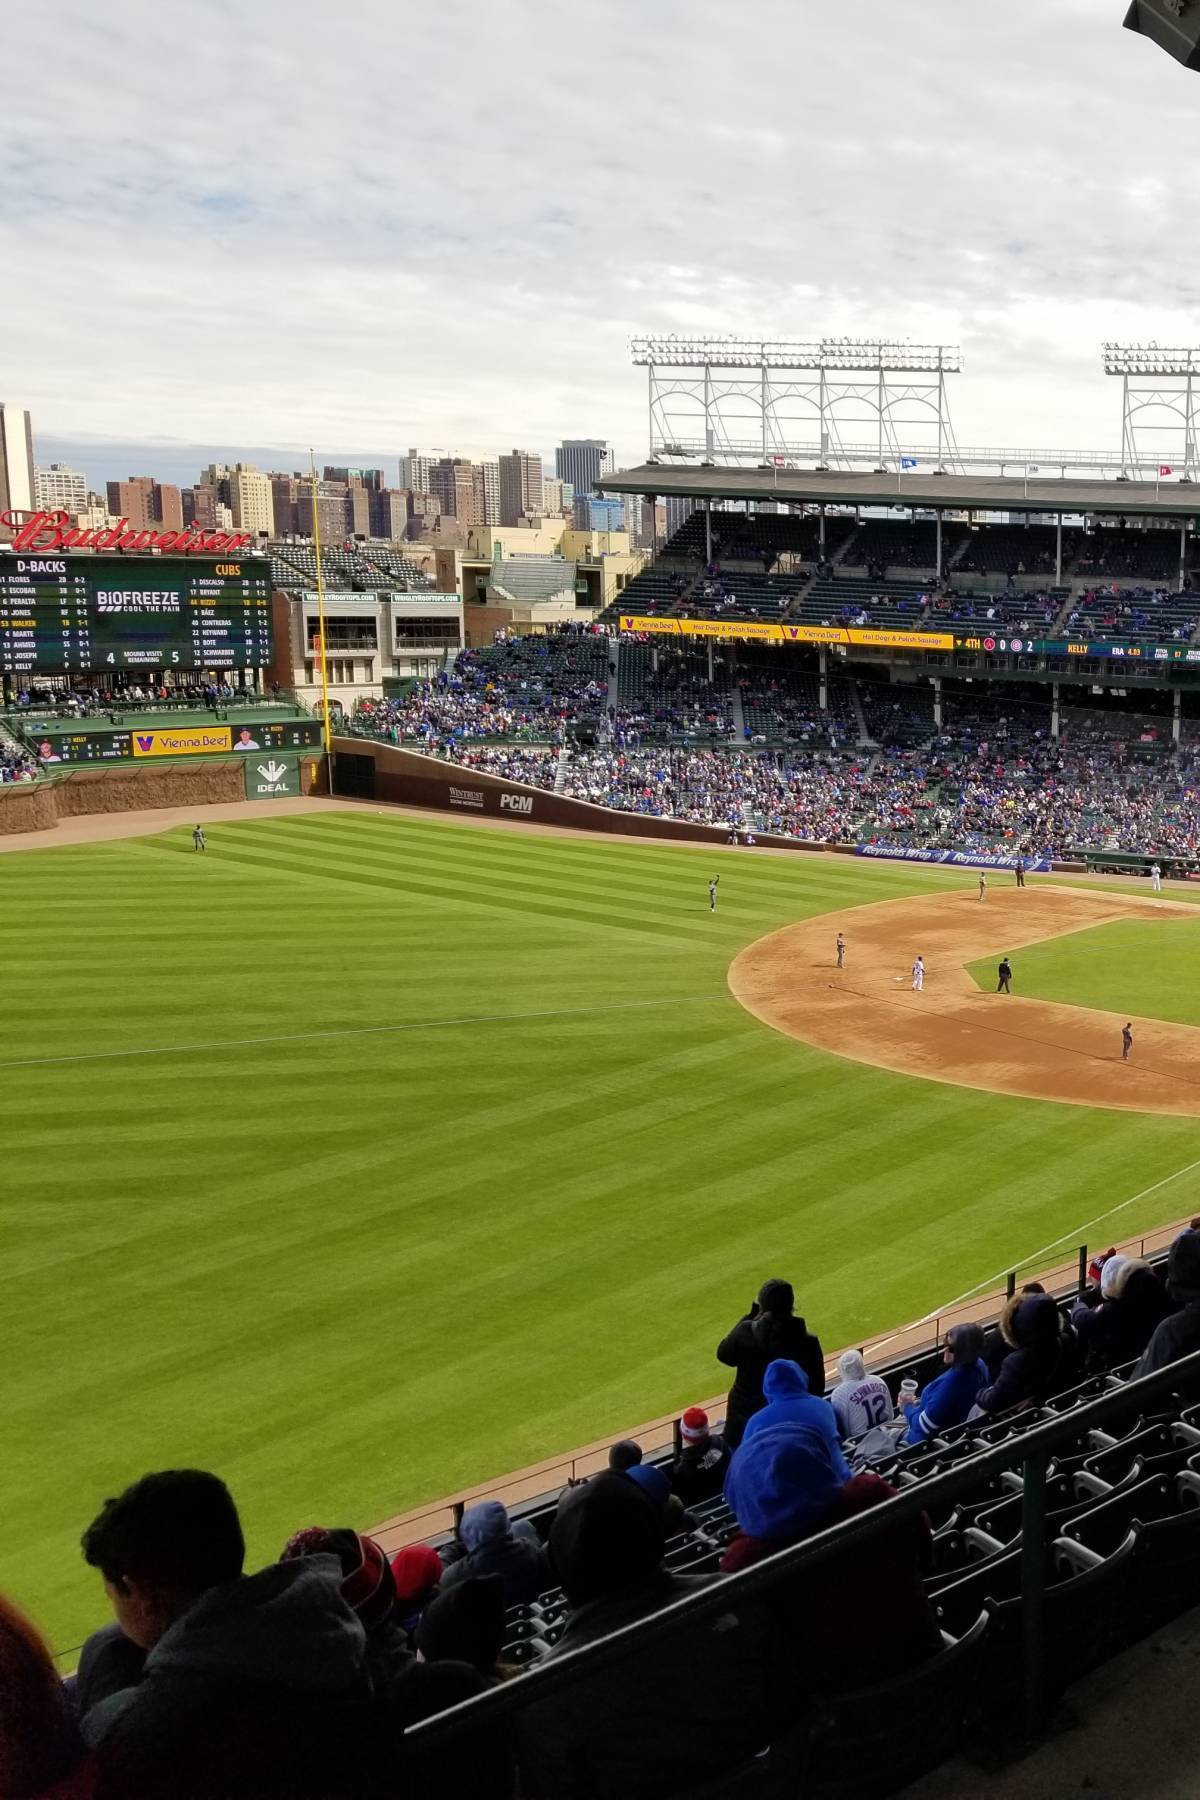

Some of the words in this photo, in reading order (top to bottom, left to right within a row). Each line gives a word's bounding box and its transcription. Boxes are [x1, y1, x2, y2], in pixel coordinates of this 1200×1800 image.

[0, 509, 251, 552] Budweiser
[17, 561, 66, 573] D-BACKS
[216, 564, 241, 576] CUBS
[638, 620, 659, 629] Vienna
[965, 638, 980, 649] 4TH
[1000, 639, 1006, 650] 0
[1027, 641, 1033, 652] 2
[1068, 644, 1088, 654] KELLY
[172, 651, 180, 663] 5
[1112, 647, 1125, 656] ERA
[107, 652, 115, 664] 4
[160, 737, 201, 748] Vienna
[202, 734, 228, 747] Beef
[257, 783, 289, 793] IDEAL
[500, 793, 534, 811] PCM
[862, 845, 907, 857] Reynolds
[952, 851, 999, 865] Reynolds
[861, 1394, 886, 1427] 12
